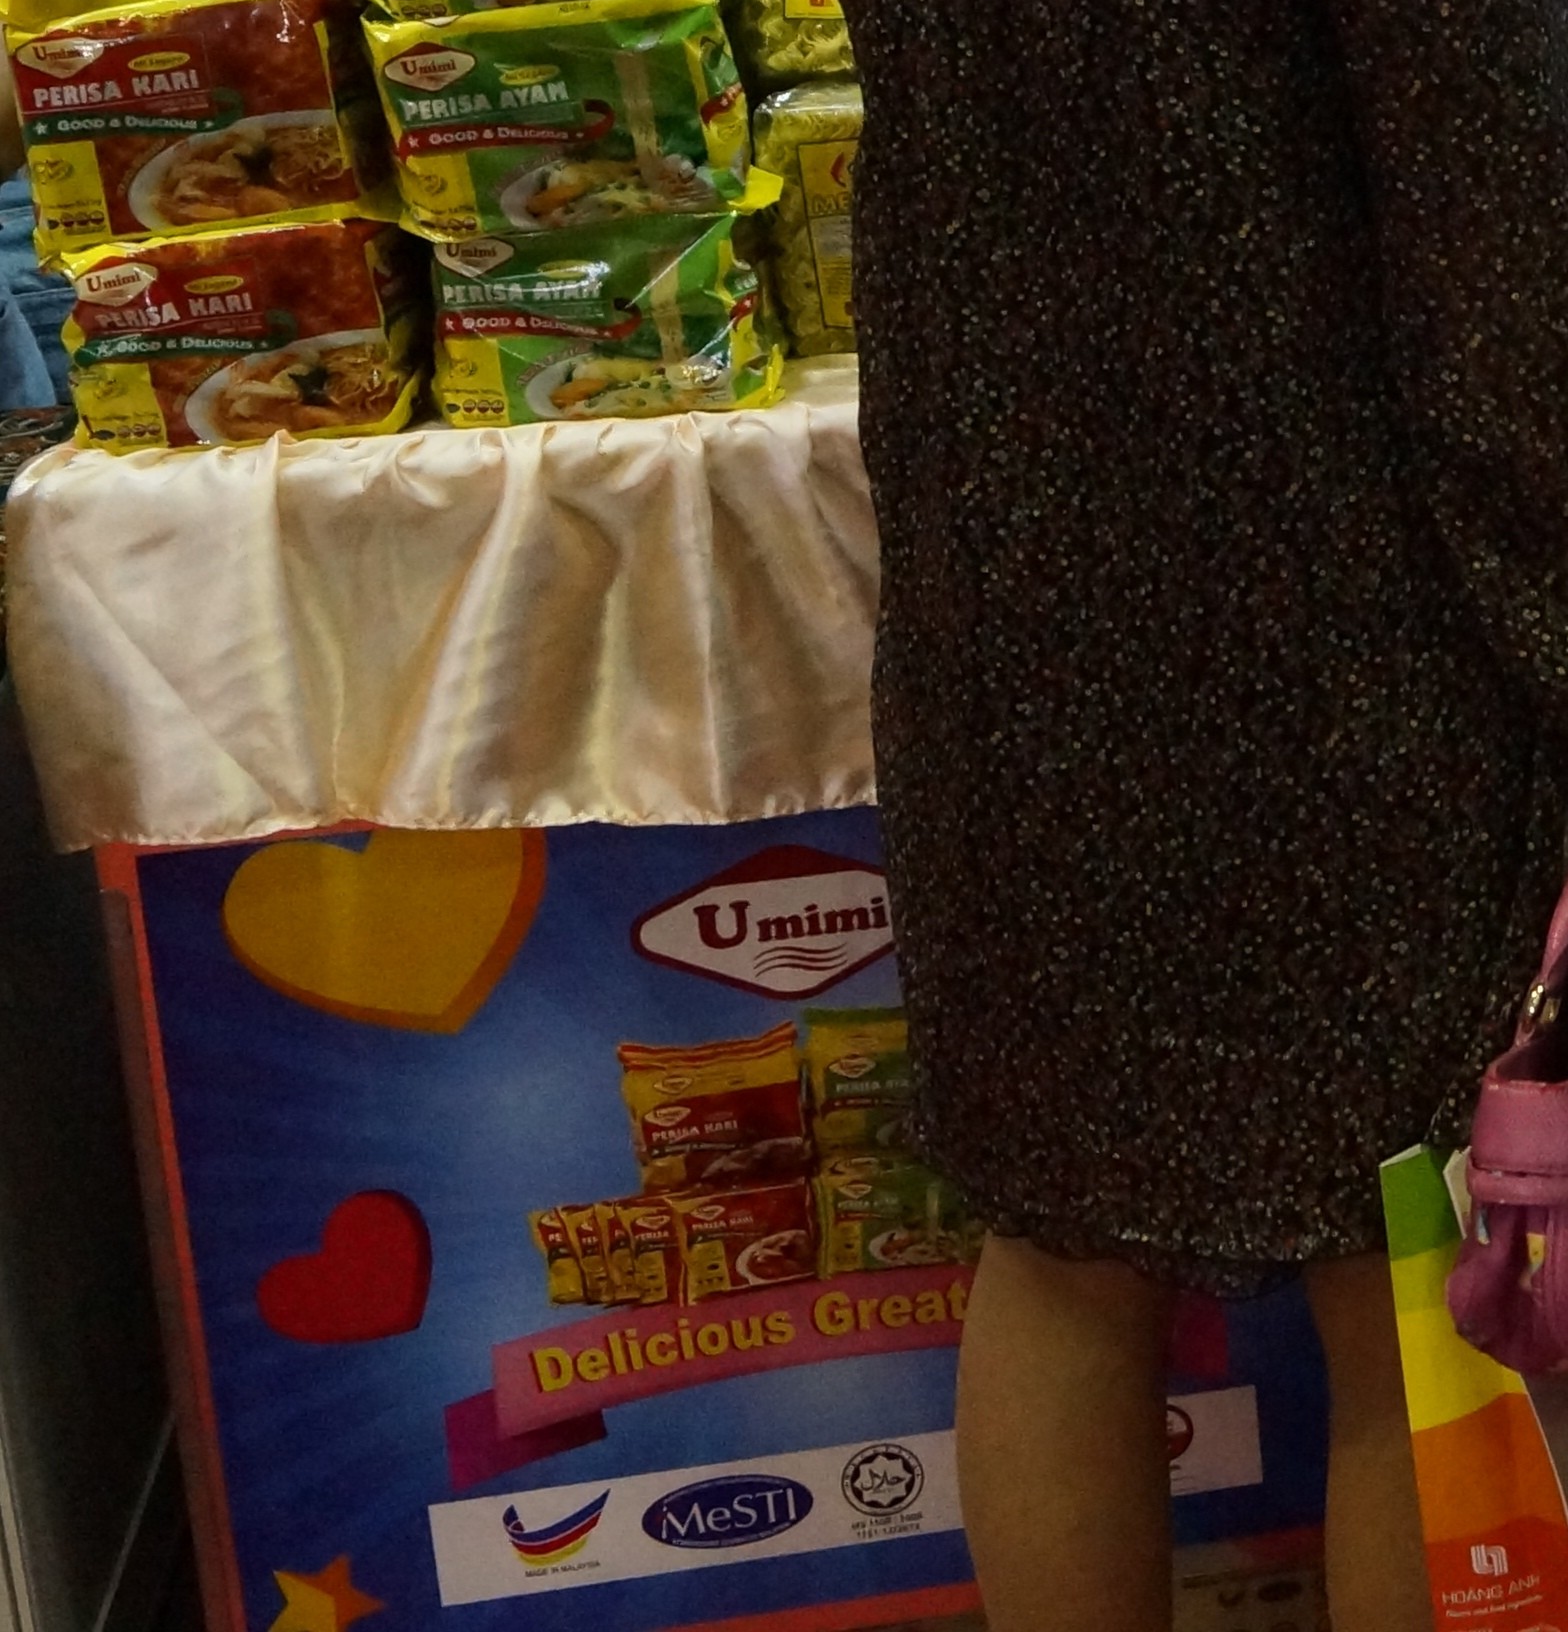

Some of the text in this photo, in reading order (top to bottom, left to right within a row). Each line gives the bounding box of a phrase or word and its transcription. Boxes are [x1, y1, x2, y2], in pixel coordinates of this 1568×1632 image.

[401, 57, 456, 75] Umimi
[33, 80, 123, 109] PERISA
[131, 69, 200, 98] KARI
[403, 80, 570, 123] PERISA AYAM
[57, 117, 106, 132] GOOD
[428, 129, 479, 145] GOOD
[497, 126, 569, 141] DELICIOUS
[86, 271, 142, 293] Umimi
[443, 282, 523, 304] PERISA
[94, 292, 255, 330] PERISA KARI
[180, 335, 255, 351] DELICIOUS
[693, 897, 889, 950] Umimi
[533, 1282, 968, 1395] Delicious Great
[660, 1487, 799, 1542] MeSTI
